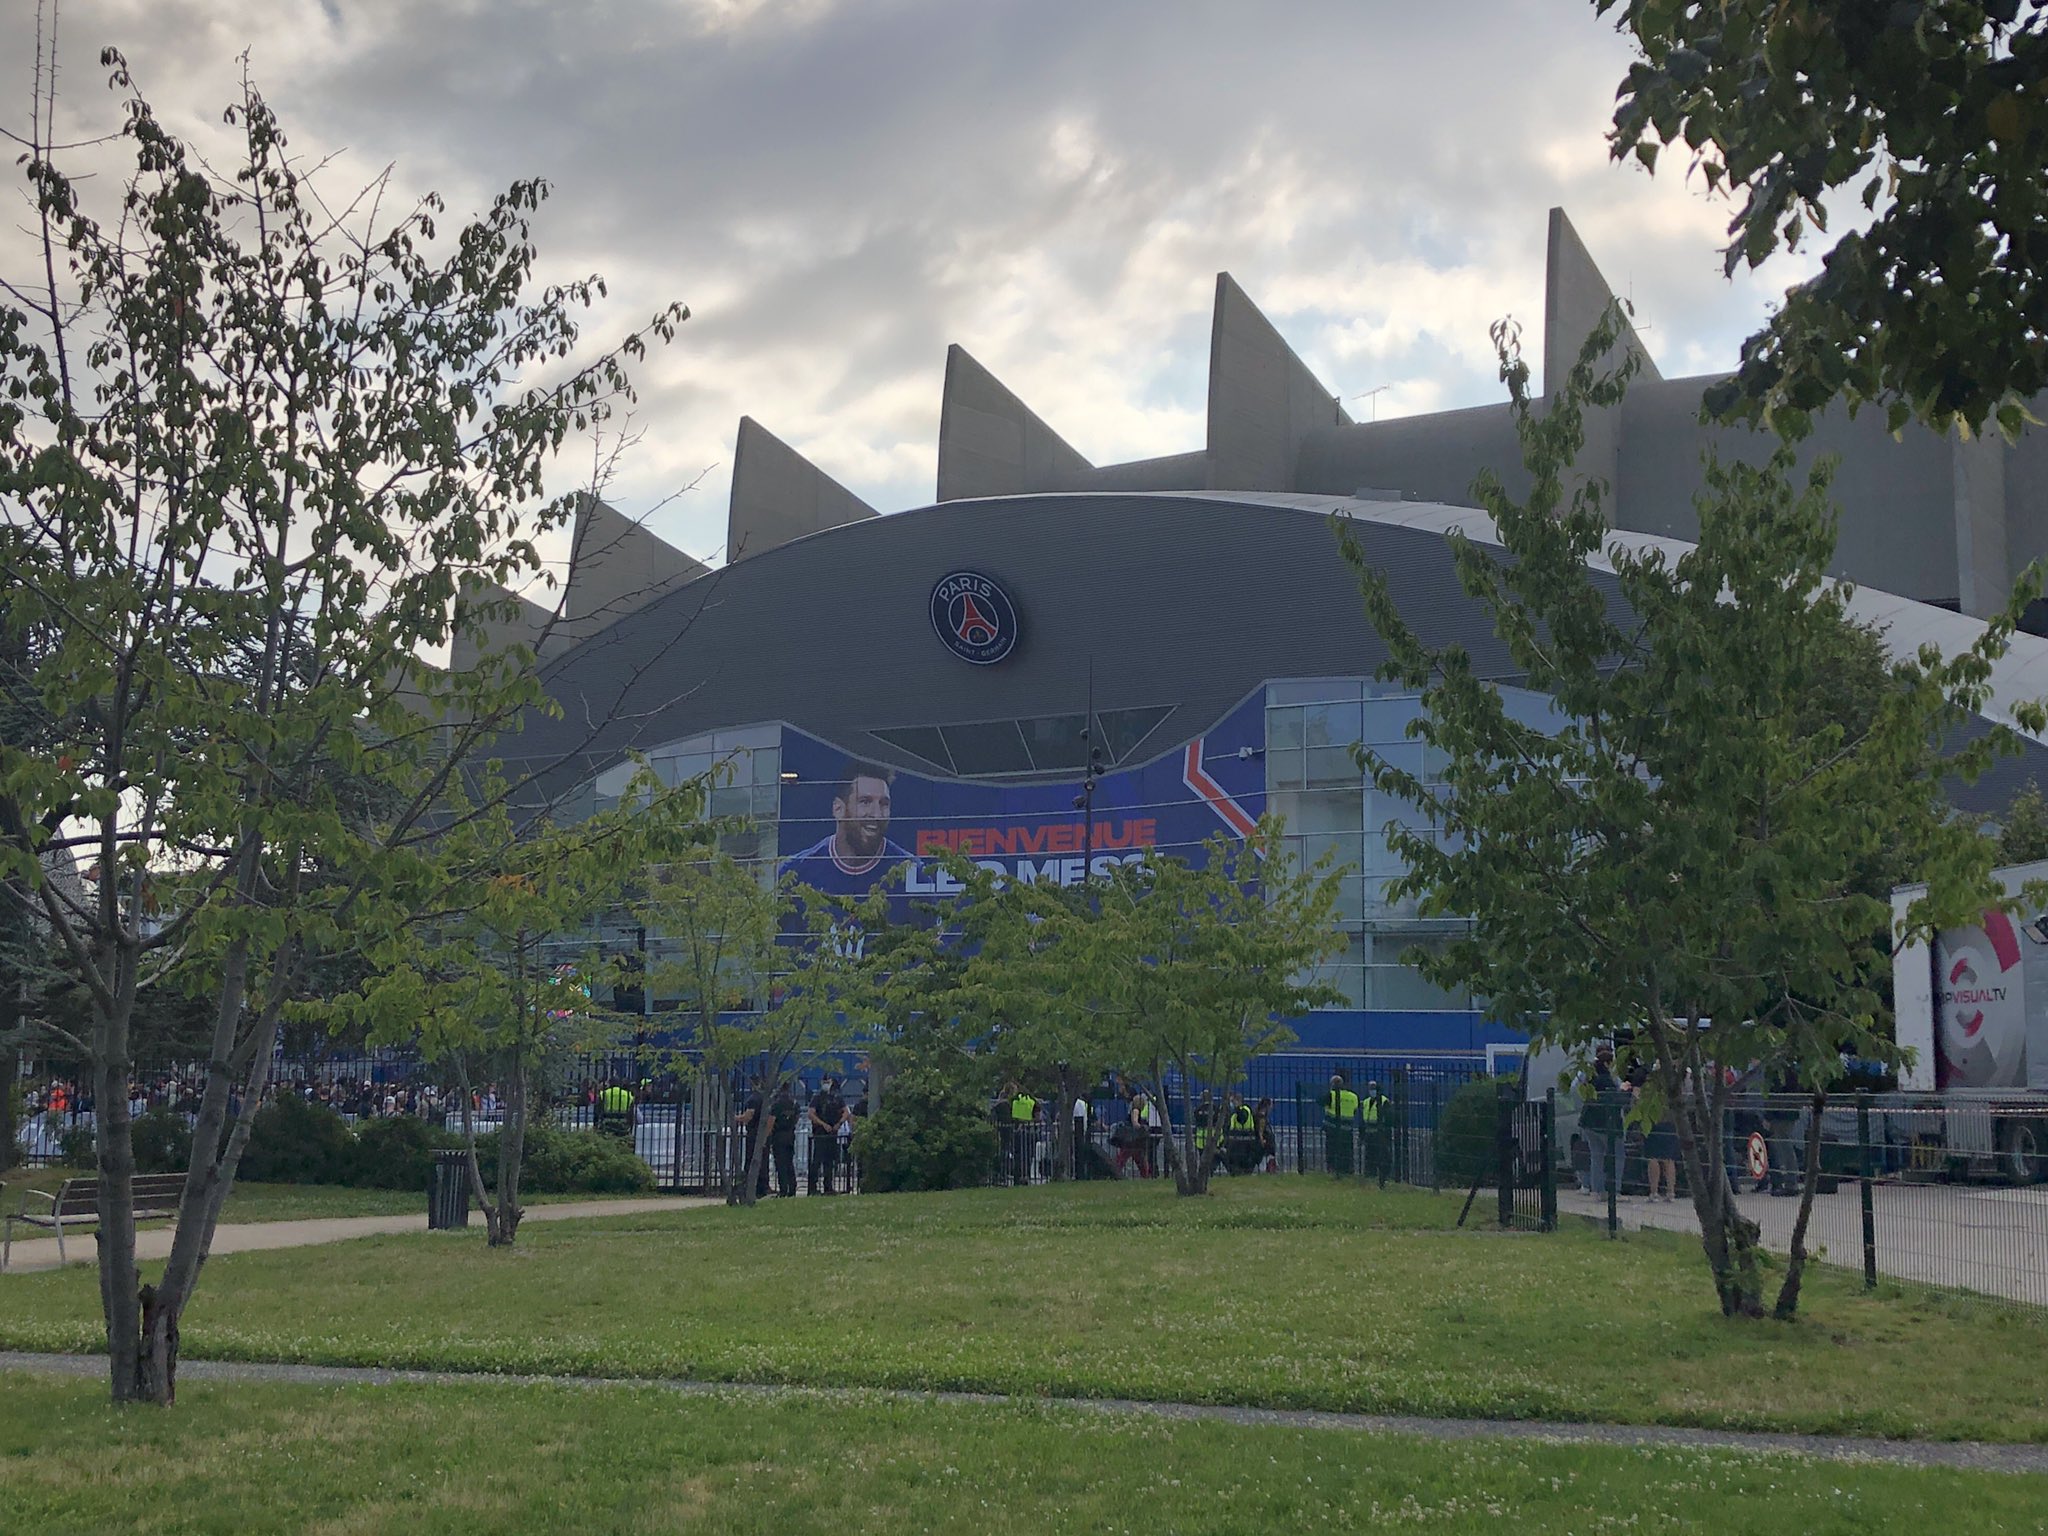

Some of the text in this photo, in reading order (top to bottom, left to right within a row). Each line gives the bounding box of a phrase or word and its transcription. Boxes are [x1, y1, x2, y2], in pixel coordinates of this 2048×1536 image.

[938, 577, 992, 602] PARIS
[916, 818, 1157, 856] BIENVENUE
[1016, 852, 1165, 890] MESS
